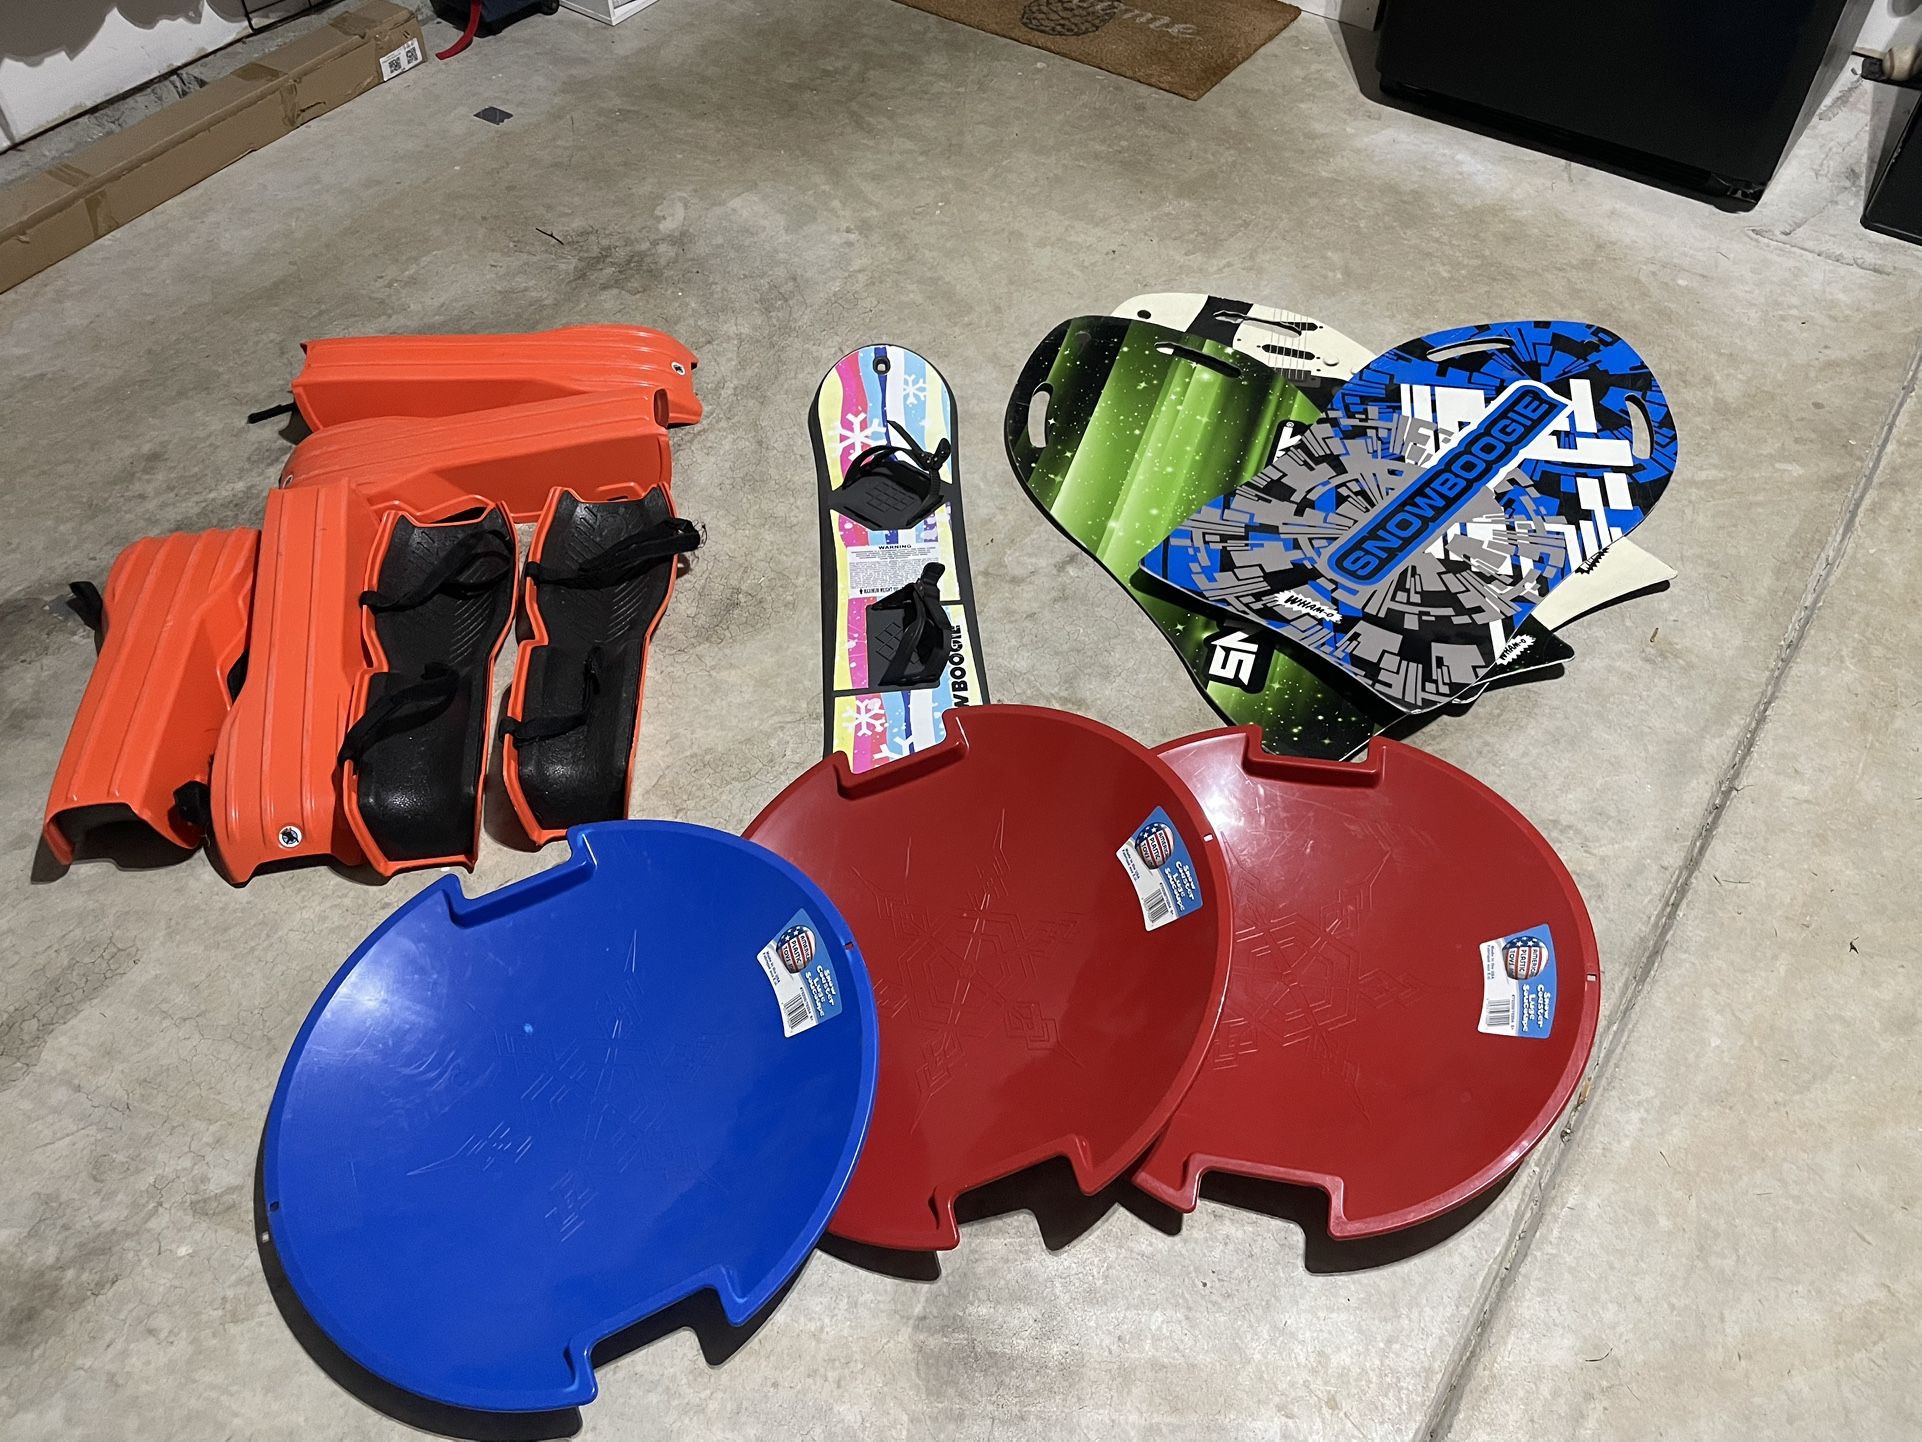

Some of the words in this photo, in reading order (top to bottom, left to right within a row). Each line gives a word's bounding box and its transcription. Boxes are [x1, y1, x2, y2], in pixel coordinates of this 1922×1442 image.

[1343, 394, 1549, 576] SNOWBOOGIE
[1284, 594, 1334, 617] WHAM-O
[1149, 837, 1160, 860] PLASTIC
[1158, 832, 1170, 858] AMERIC
[791, 940, 802, 963] PLASTIC
[1519, 949, 1527, 972] PLASTIC
